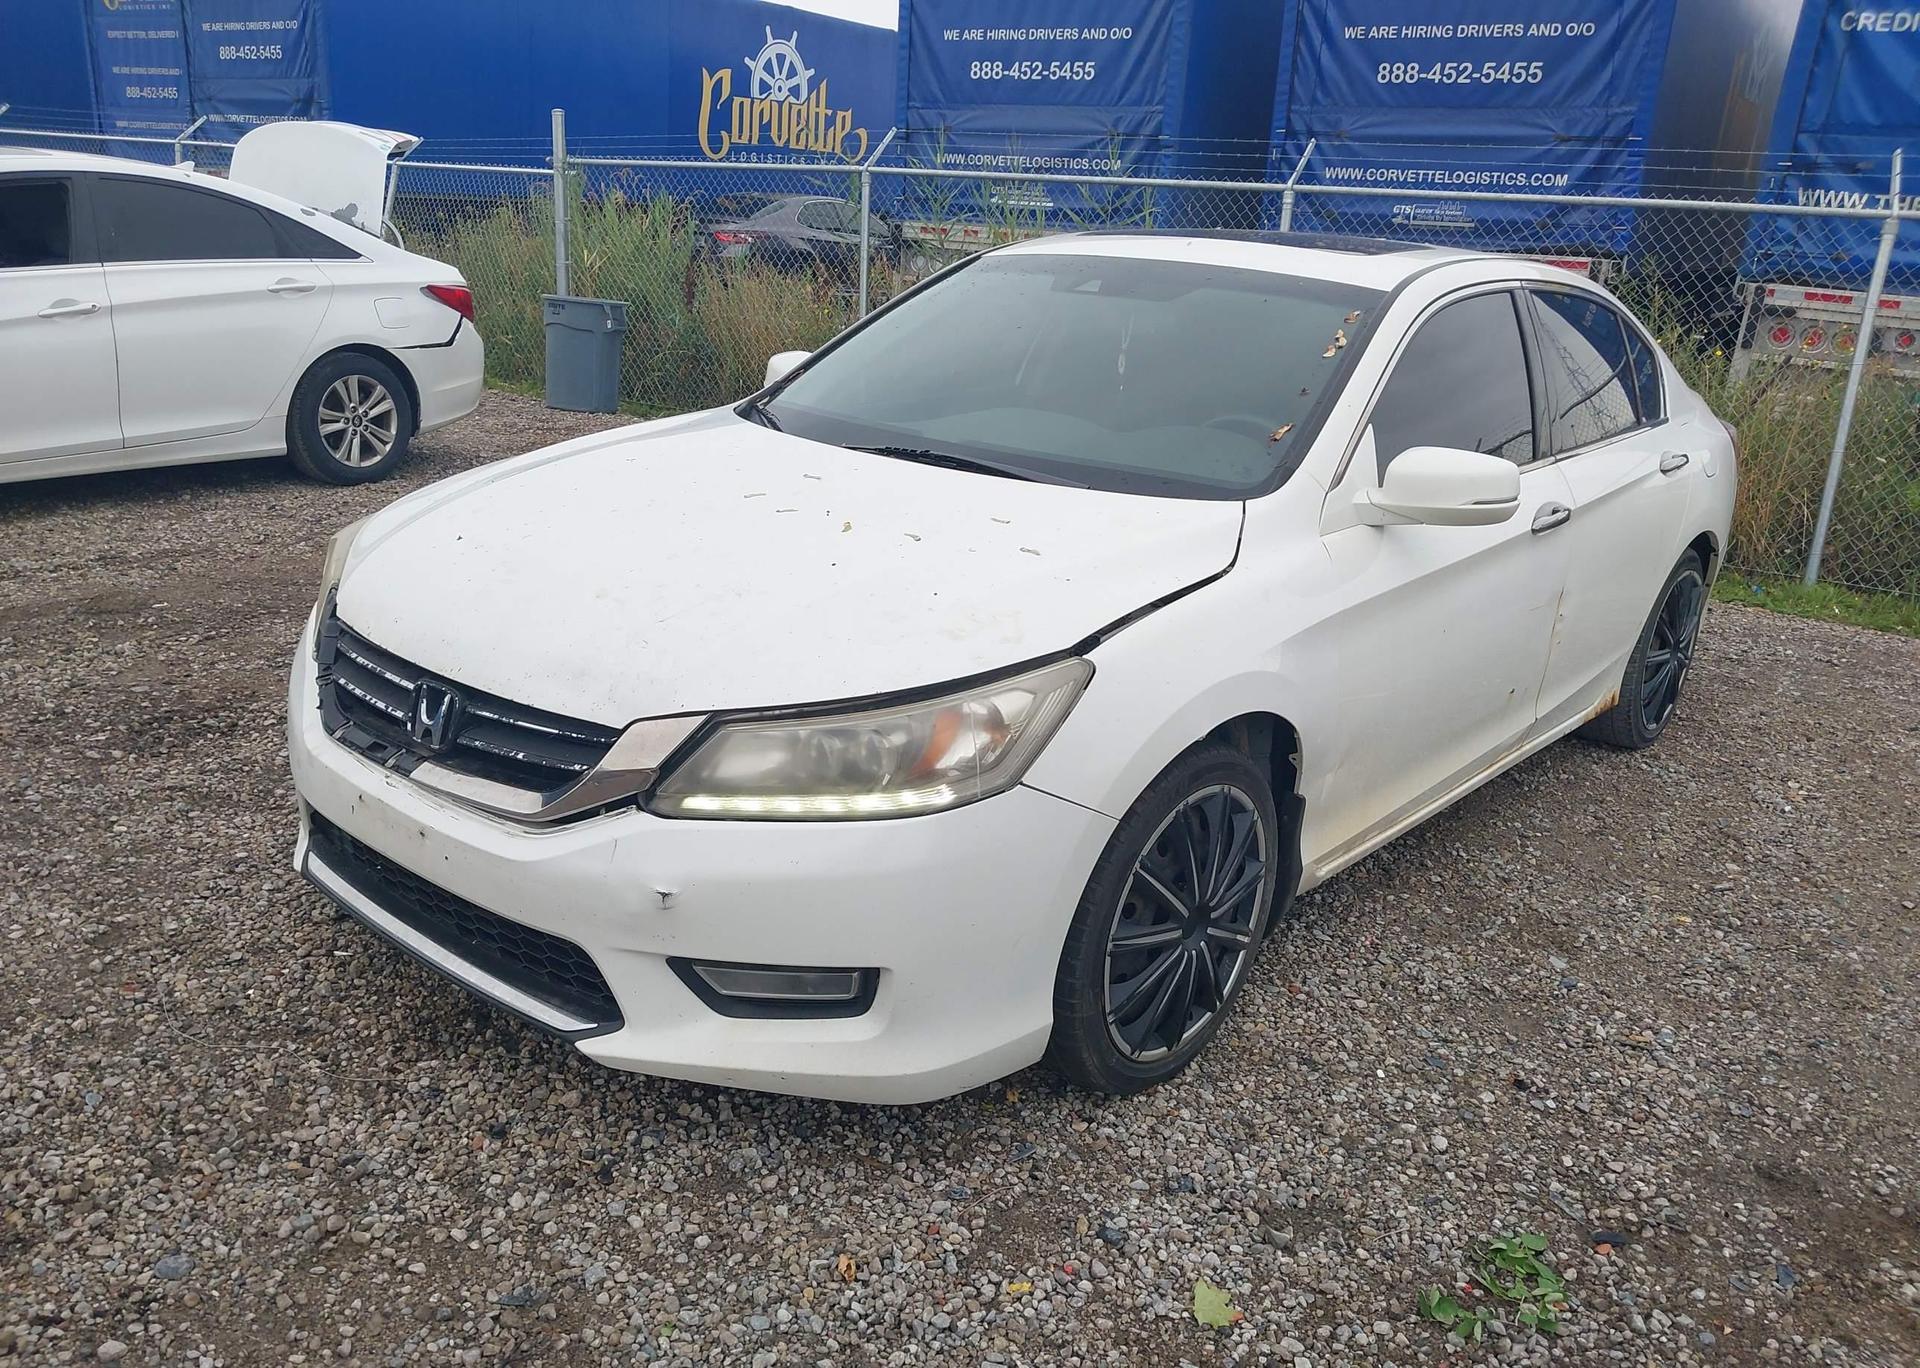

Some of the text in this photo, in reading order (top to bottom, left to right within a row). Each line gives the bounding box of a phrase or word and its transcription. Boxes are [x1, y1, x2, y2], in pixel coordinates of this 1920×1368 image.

[202, 22, 212, 31] WE
[212, 22, 224, 31] ARE
[224, 22, 245, 31] HIRING
[246, 21, 271, 30] DRIVERS
[271, 21, 285, 30] AND
[1344, 22, 1595, 39] WE ARE HIRING DRIVERS AND O/O
[944, 27, 1132, 41] WE ARE HIRING DRIVERS AND O/O
[219, 46, 283, 60] 888-452-5455
[970, 61, 1096, 80] 888-452-5455
[1376, 62, 1545, 84] 888-452-5455
[126, 86, 178, 99] 888-452-5455
[731, 151, 806, 165] LOGISTICS
[1325, 166, 1568, 187] WWW.CORVETTELOGISTICS.COM
[1393, 205, 1411, 214] GTS
